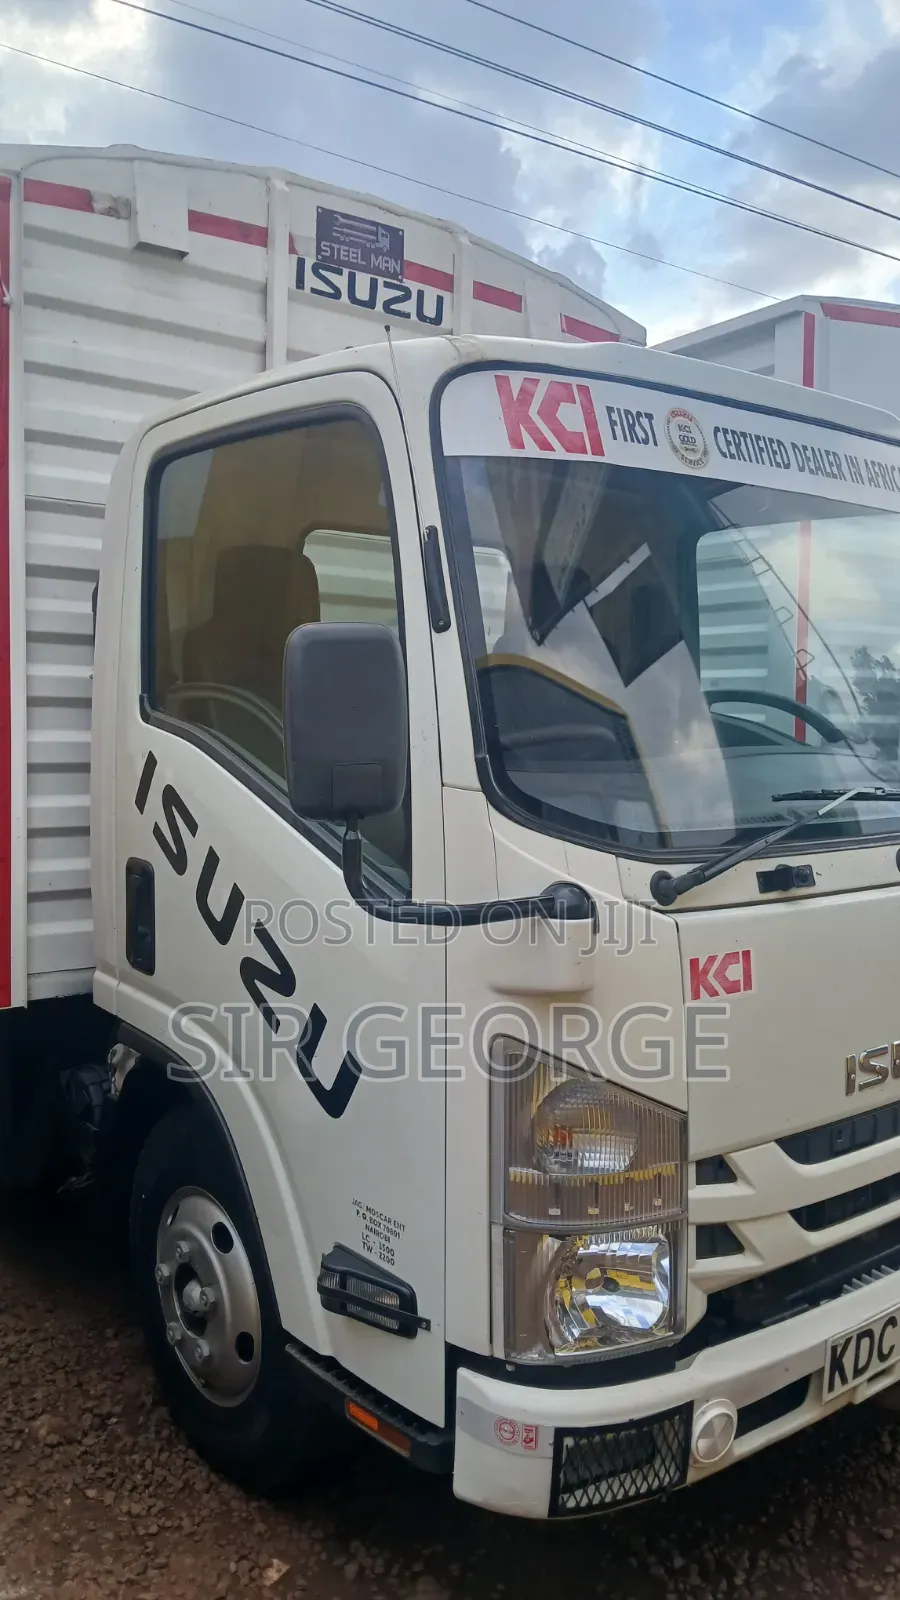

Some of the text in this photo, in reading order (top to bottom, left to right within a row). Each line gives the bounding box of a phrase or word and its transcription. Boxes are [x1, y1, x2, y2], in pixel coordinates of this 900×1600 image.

[320, 240, 401, 273] STEEL MAN
[295, 256, 444, 327] ISUZU
[494, 374, 606, 457] KCI
[605, 405, 659, 447] FIRST
[669, 409, 693, 422] ISUZU
[679, 434, 696, 444] GOLD
[713, 425, 791, 470] CERTIFIED
[790, 441, 848, 482] DEALER
[844, 453, 866, 486] IN
[863, 458, 900, 493] AFRIC
[135, 750, 362, 1119] ISUZU
[689, 949, 753, 1001] KCI
[361, 1232, 370, 1243] LC
[361, 1241, 373, 1254] TW
[828, 1315, 898, 1394] KDC
